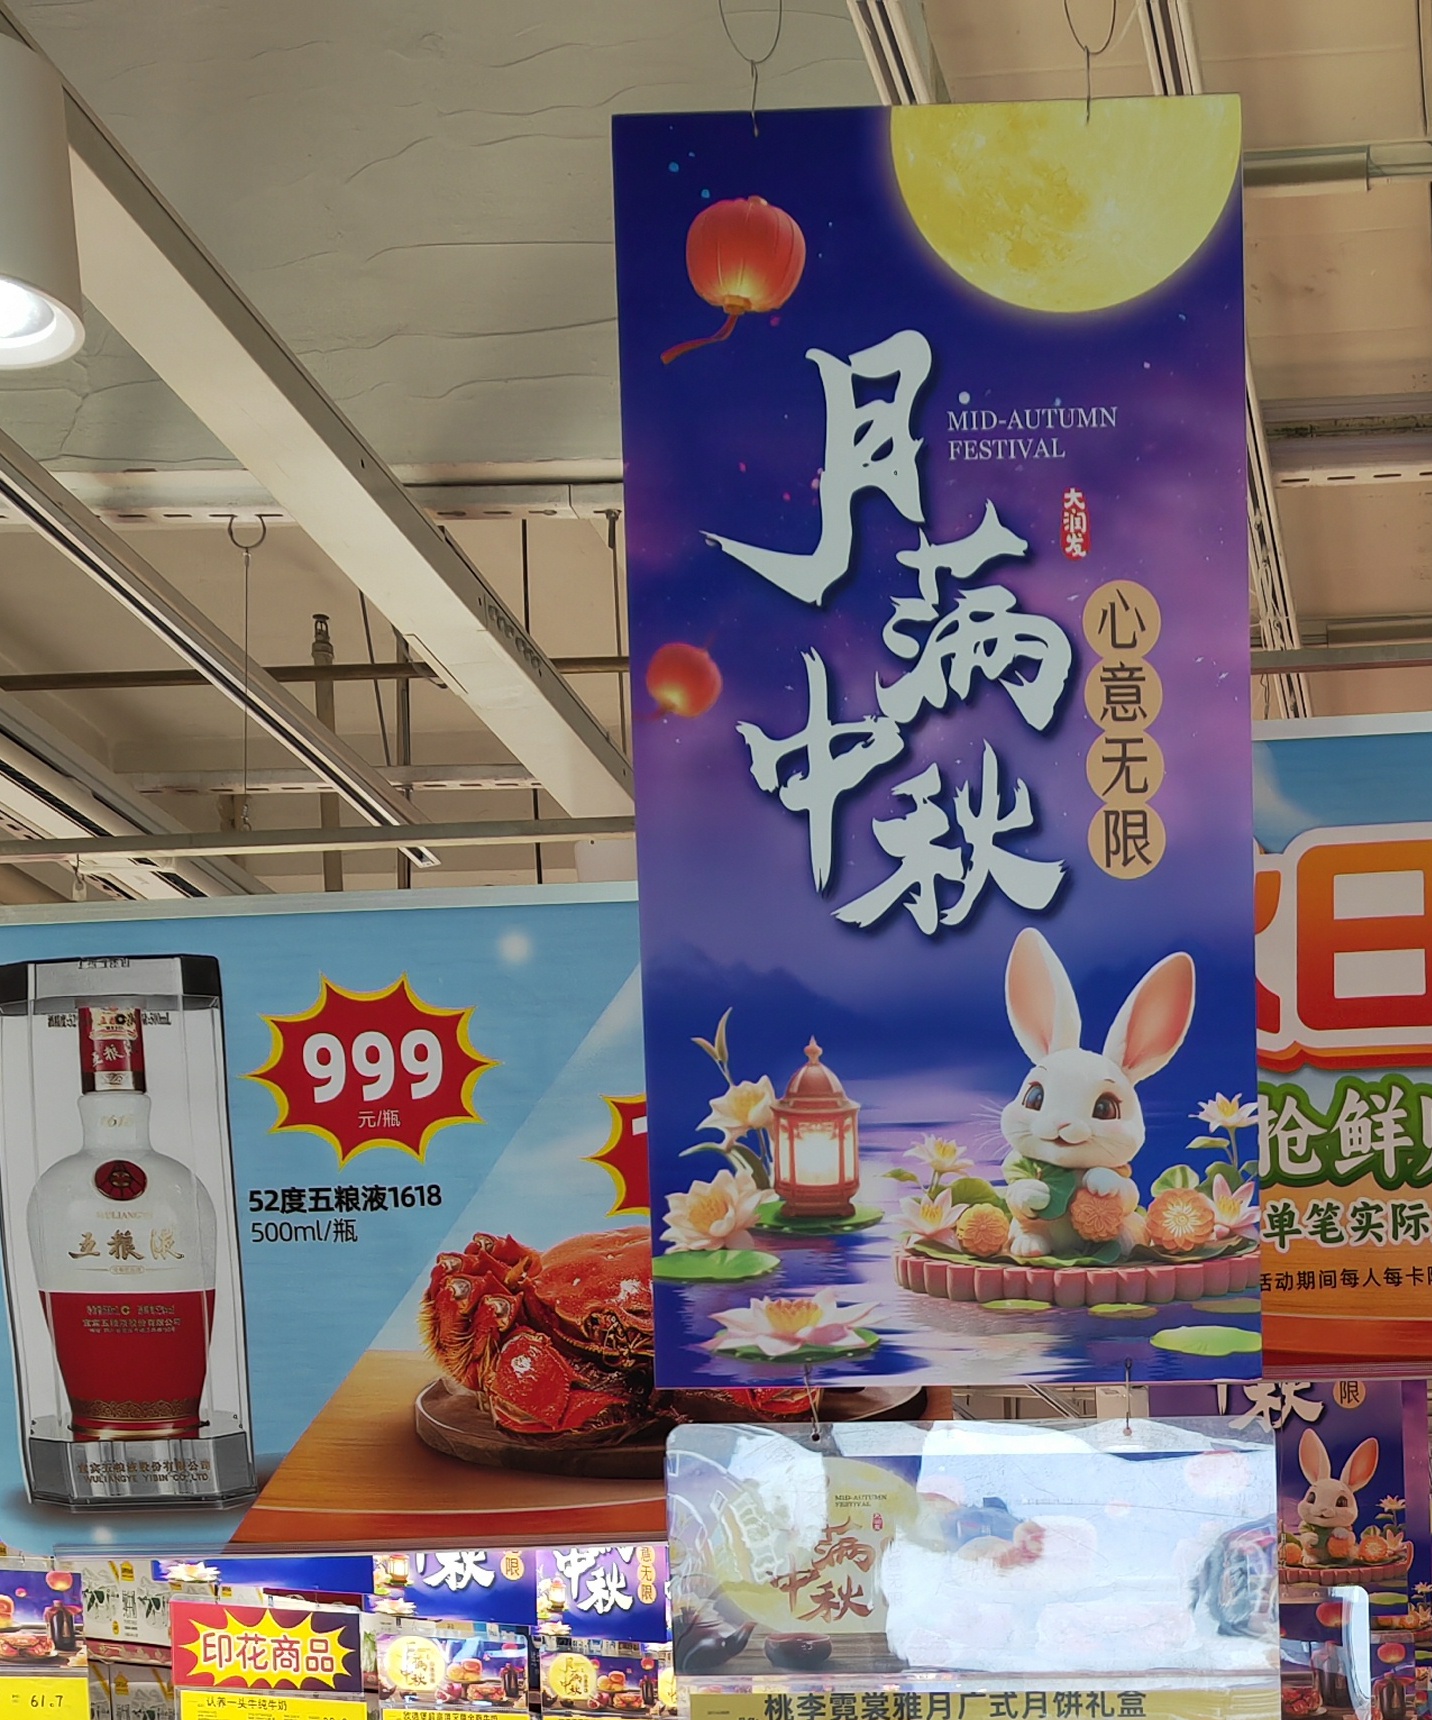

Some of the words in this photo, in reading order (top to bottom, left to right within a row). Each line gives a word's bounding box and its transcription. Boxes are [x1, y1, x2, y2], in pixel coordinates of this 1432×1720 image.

[947, 405, 1118, 433] MID-AUTUMN
[947, 436, 1066, 461] FESTIVAL
[1063, 488, 1088, 558] 大润发
[1098, 588, 1153, 869] 心意无限
[302, 1028, 445, 1104] 999
[358, 1109, 401, 1129] 元/瓶
[248, 1184, 443, 1215] 52度五粮液1618
[68, 1228, 185, 1260] 五粮液
[250, 1217, 359, 1243] 500ml/瓶
[201, 1633, 336, 1674] 印花商品
[206, 1696, 288, 1712] 认养一头牛纯牛奶
